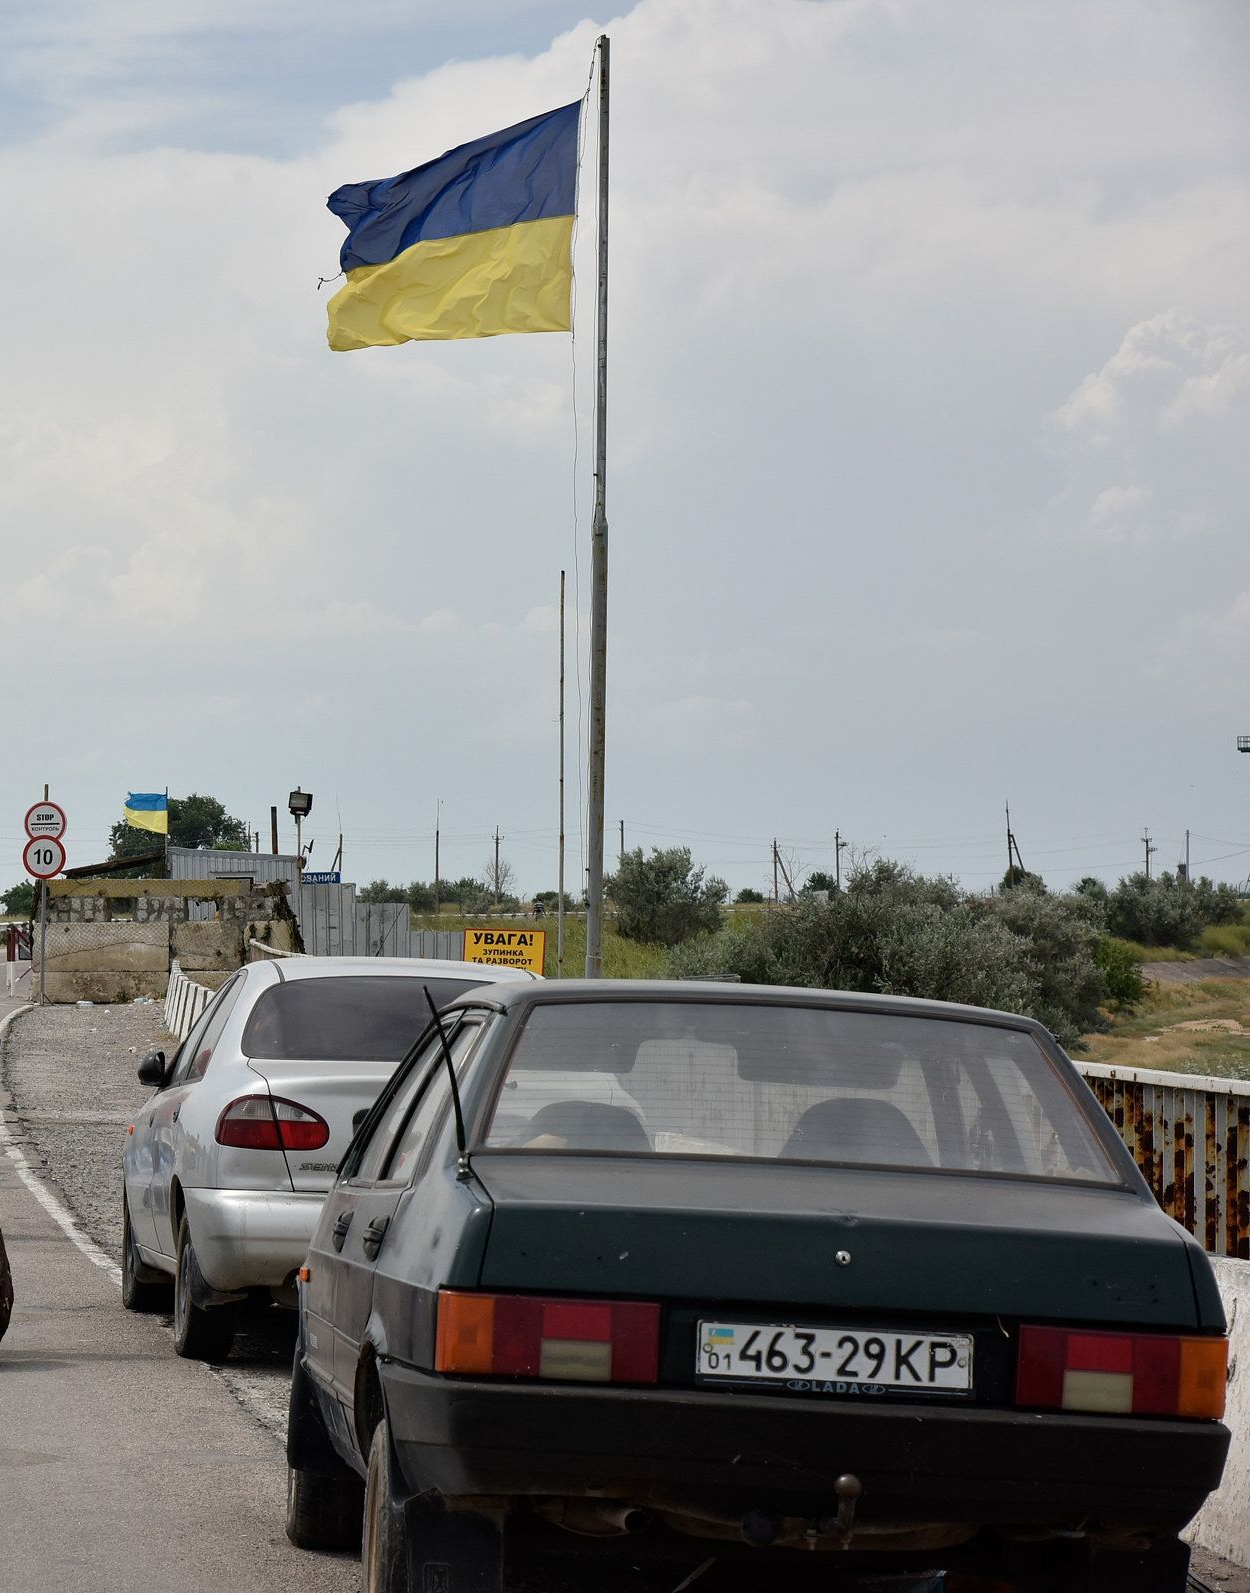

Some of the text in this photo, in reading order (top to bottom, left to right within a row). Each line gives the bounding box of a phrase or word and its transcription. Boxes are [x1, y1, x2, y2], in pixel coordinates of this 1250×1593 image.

[36, 813, 54, 821] STOP
[33, 848, 53, 865] 10
[473, 932, 534, 946] УВАГА!
[483, 948, 524, 957] ЗУПИНКА
[472, 956, 533, 966] ТА РАЗВОРОТ
[811, 1380, 860, 1394] LADA
